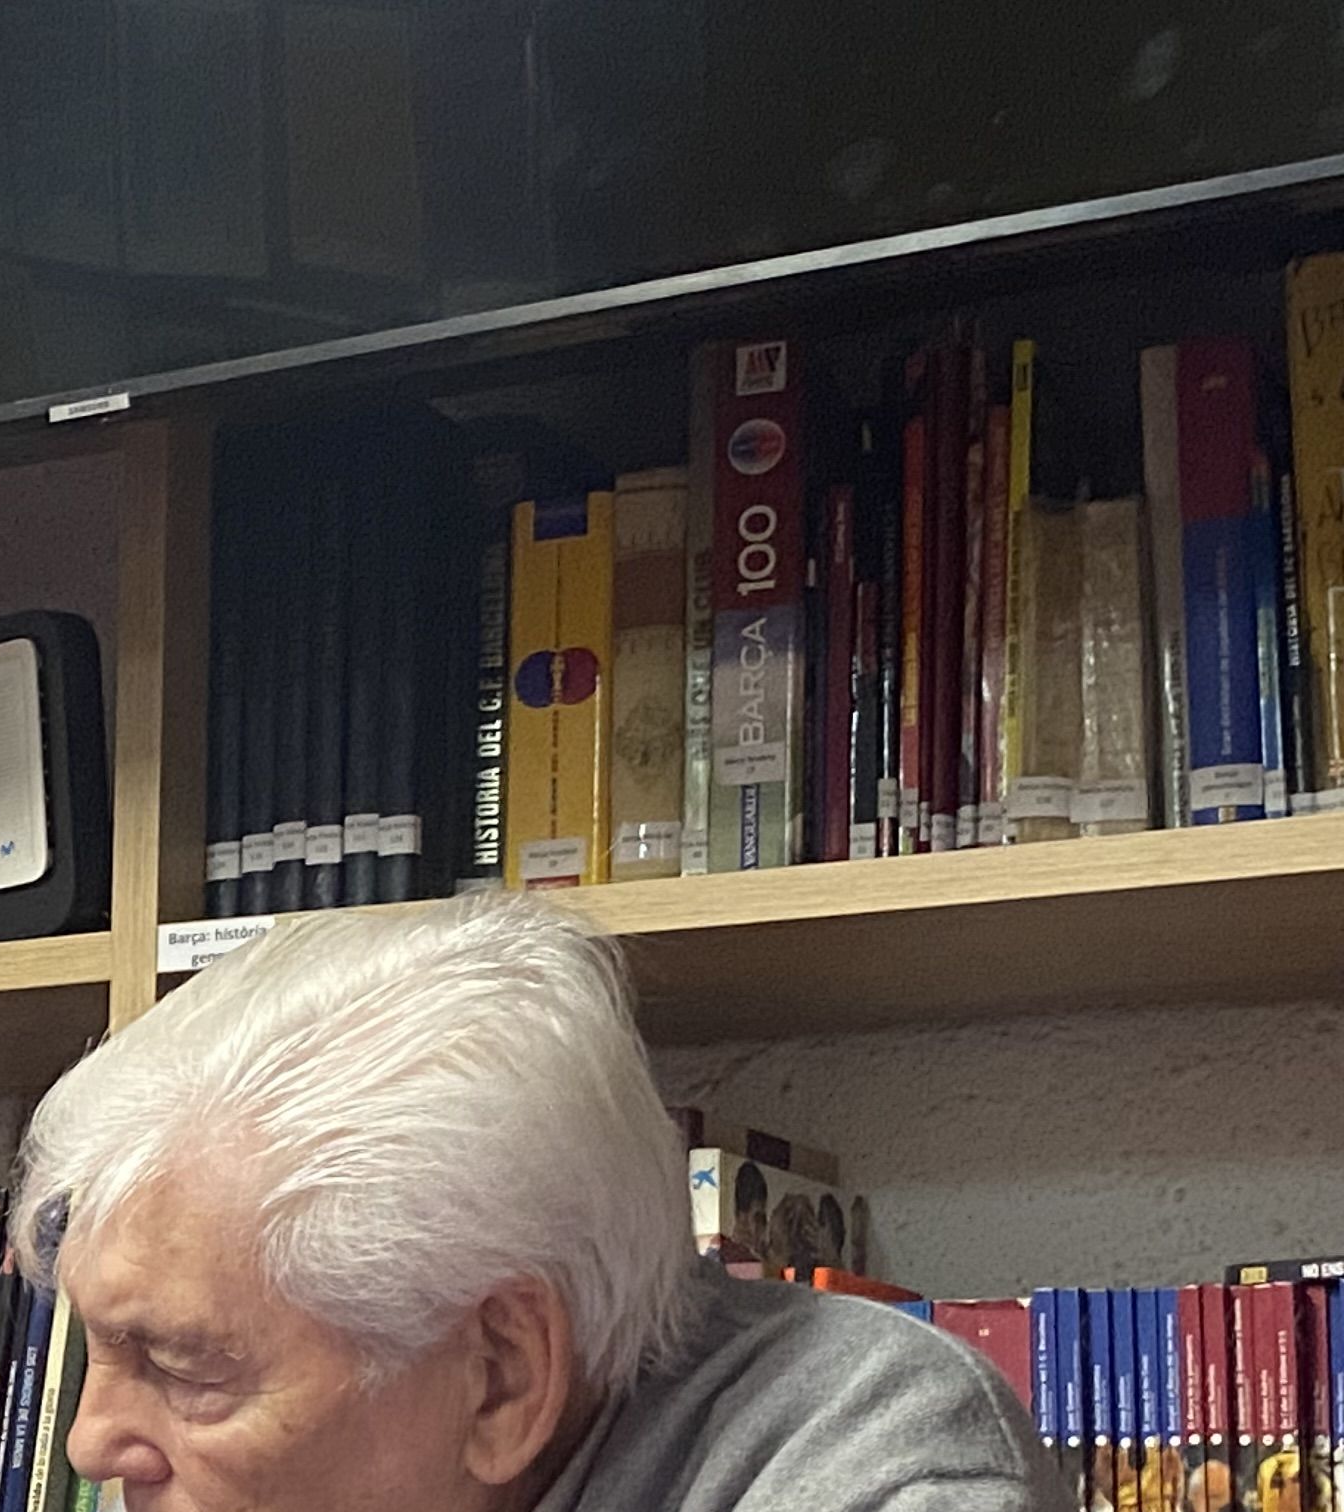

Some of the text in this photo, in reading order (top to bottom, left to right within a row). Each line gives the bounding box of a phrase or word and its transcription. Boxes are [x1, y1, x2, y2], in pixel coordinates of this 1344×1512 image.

[736, 504, 778, 597] 100
[739, 617, 775, 747] BARÇA
[477, 719, 503, 758] DEL
[474, 766, 501, 865] HISTORIA
[169, 932, 211, 945] Barça:
[1300, 1263, 1320, 1279] NO
